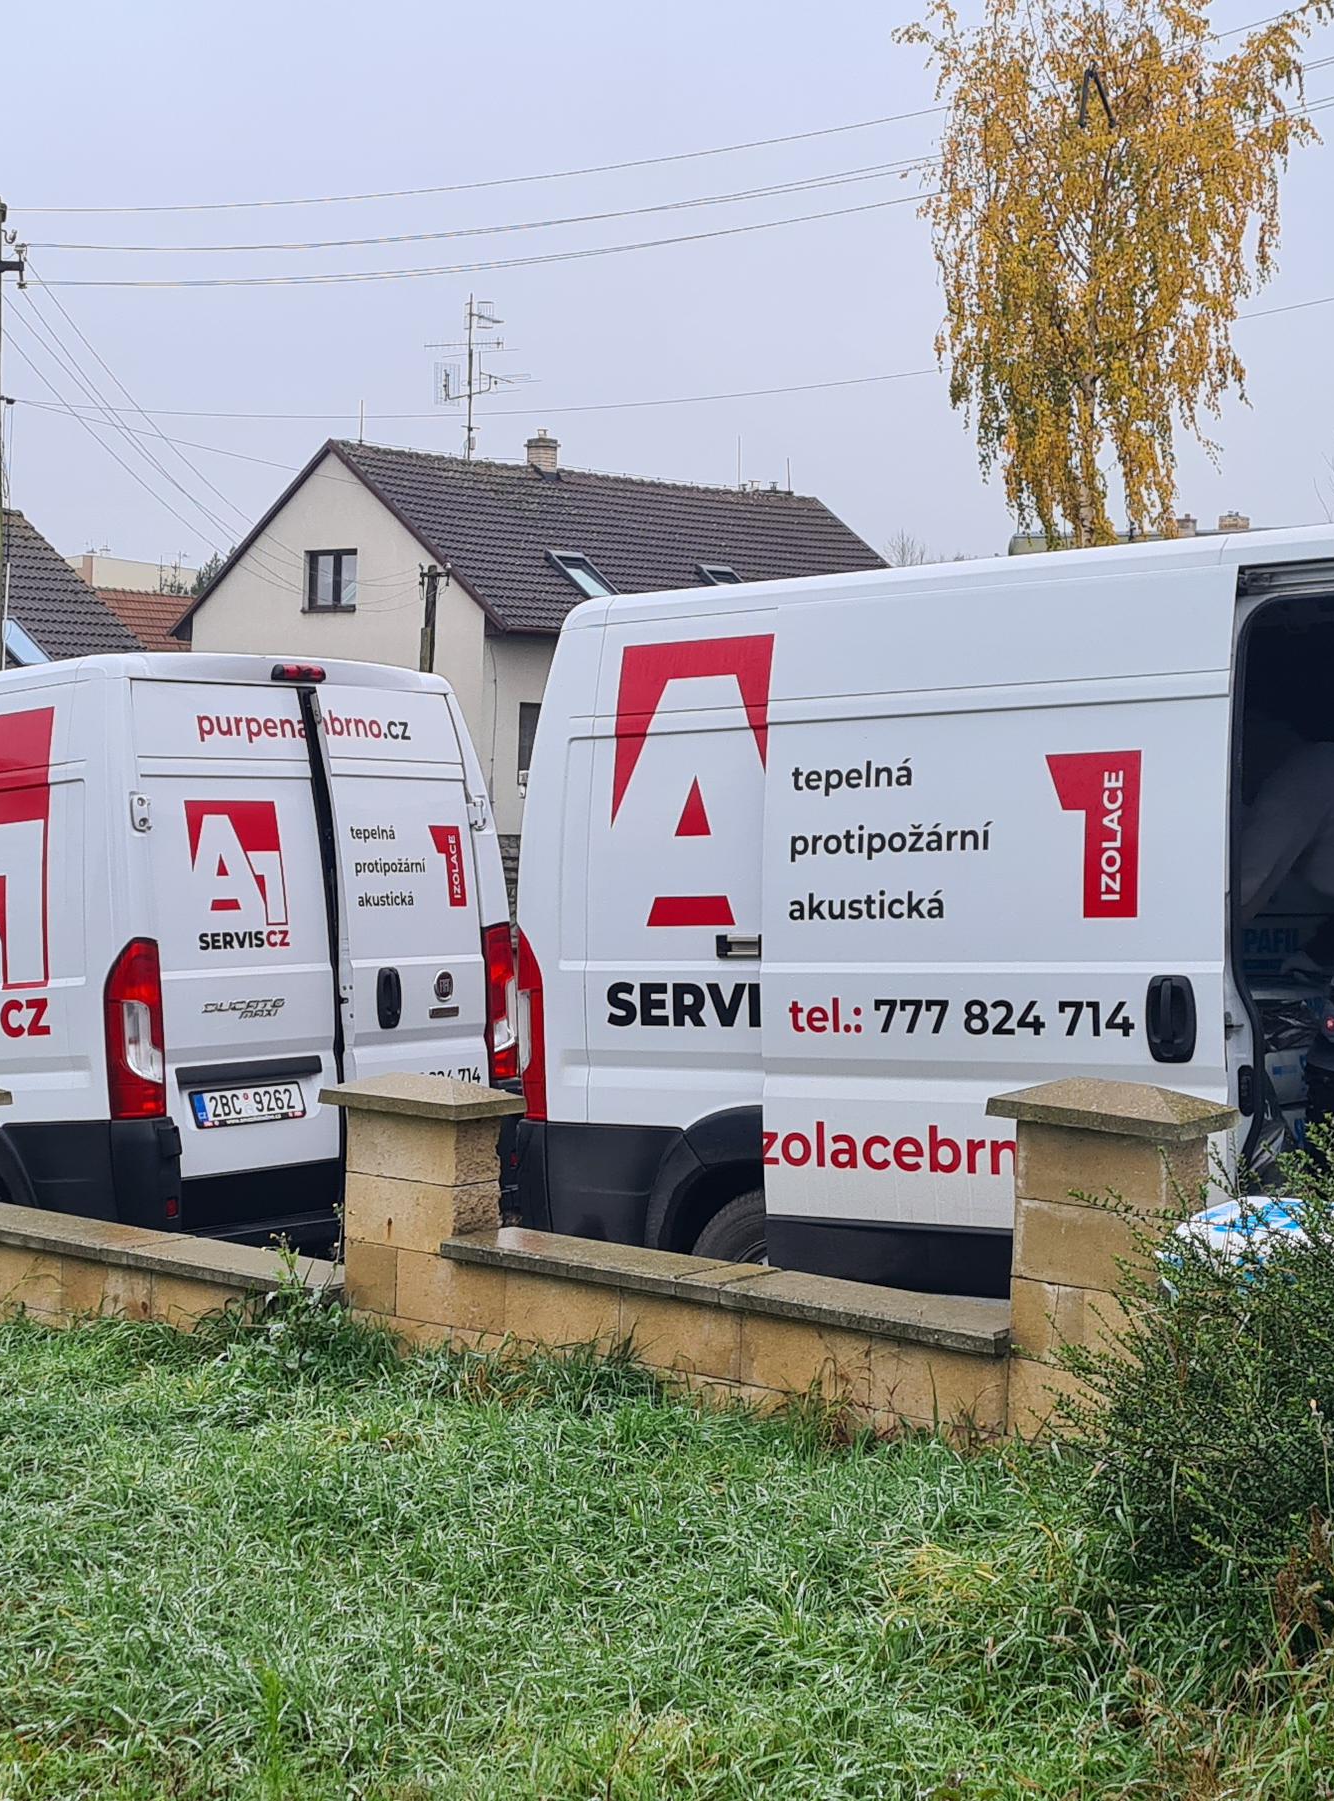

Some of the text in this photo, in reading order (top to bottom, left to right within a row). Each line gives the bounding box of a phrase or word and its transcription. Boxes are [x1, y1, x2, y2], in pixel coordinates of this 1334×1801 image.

[792, 758, 913, 797] tepelná
[350, 825, 396, 843] tepelná
[790, 821, 993, 863] protipožární
[1101, 770, 1124, 901] IZOLACE
[184, 800, 289, 926] A1
[354, 857, 426, 877] protipožární
[447, 834, 462, 899] IZOLACE
[357, 890, 415, 908] akustická
[788, 890, 945, 921] akustická
[202, 998, 285, 1013] DUCATO
[606, 981, 762, 1028] SERVI
[788, 997, 1135, 1037] tel.: 777 824 714
[209, 1088, 296, 1118] 2BC 9262
